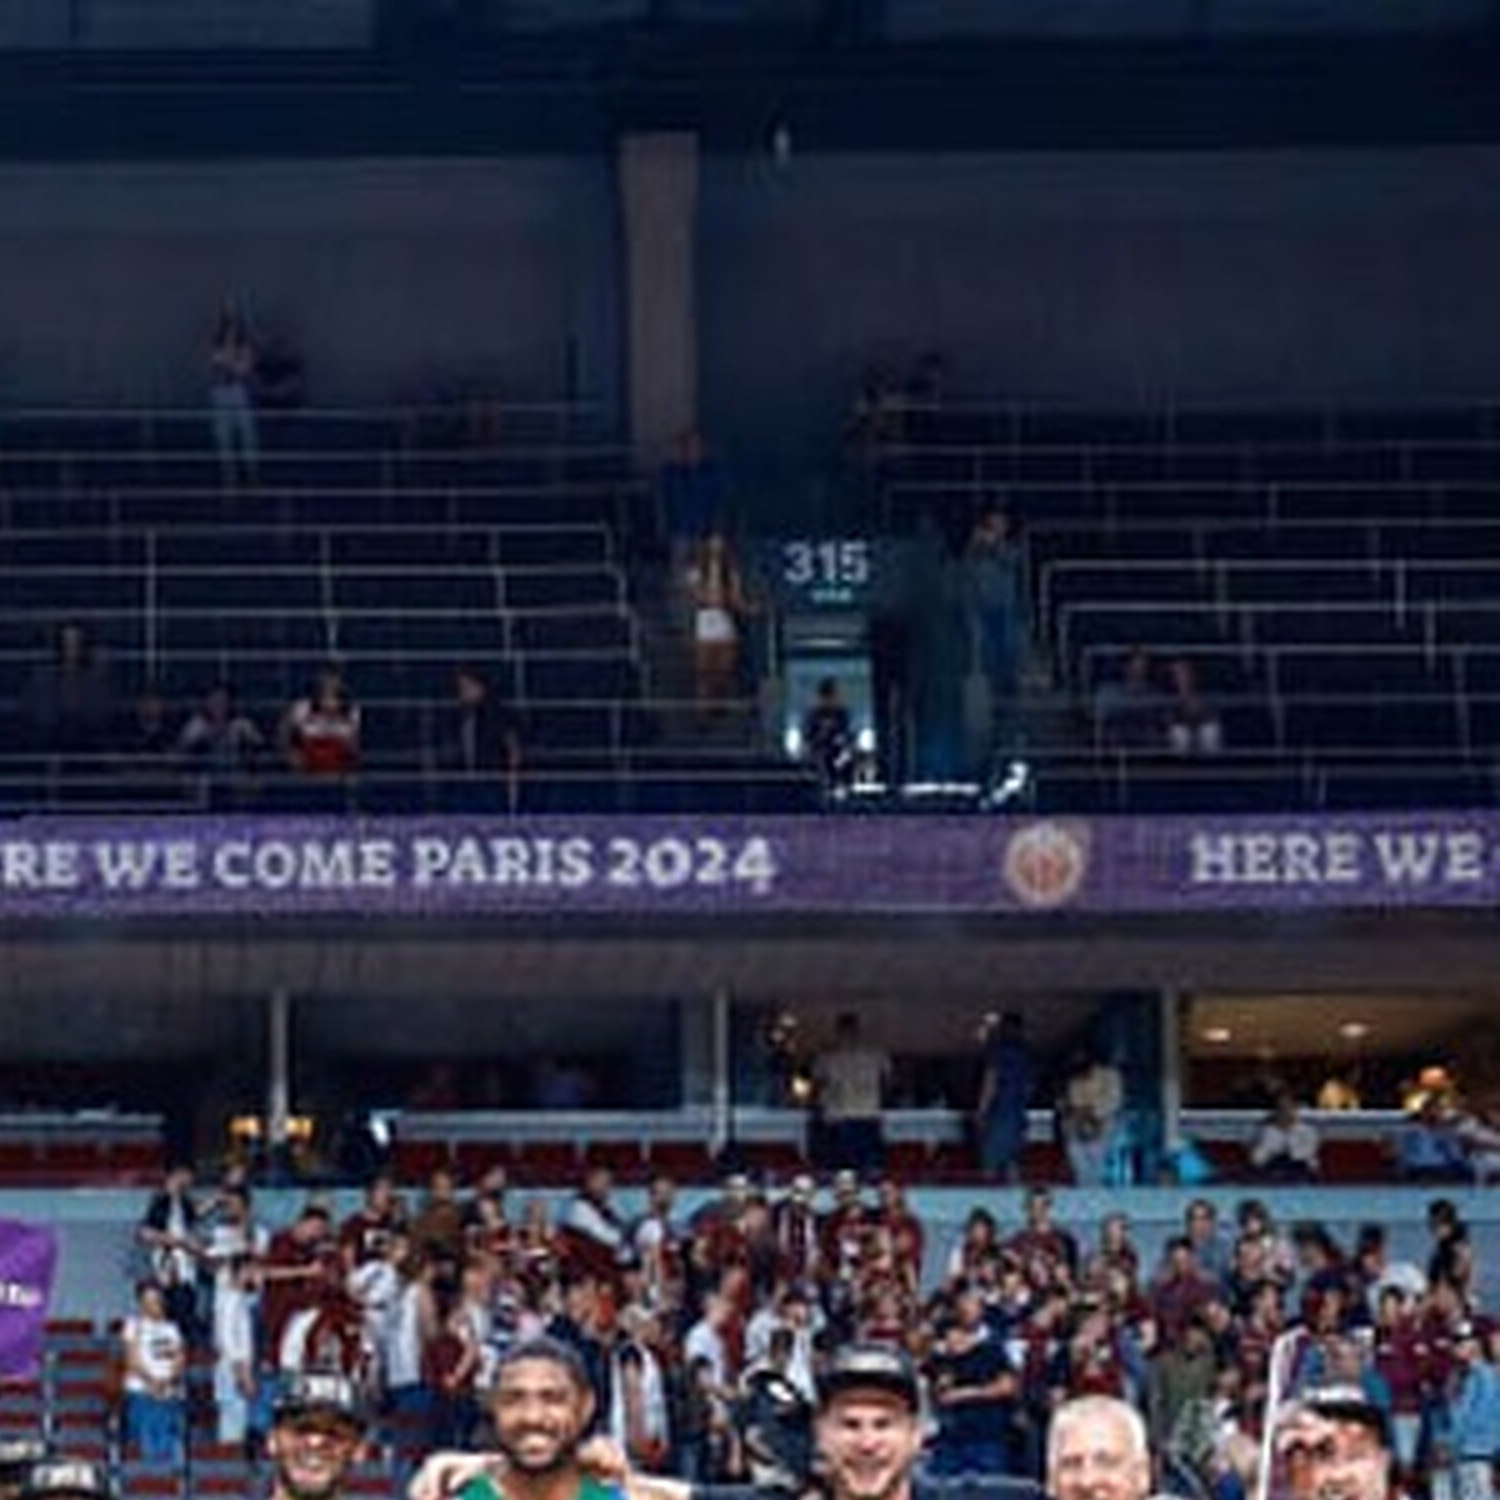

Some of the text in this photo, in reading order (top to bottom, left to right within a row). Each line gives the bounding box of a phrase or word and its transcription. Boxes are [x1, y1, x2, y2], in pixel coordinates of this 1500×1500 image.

[784, 541, 868, 583] 315
[98, 841, 199, 887] WE
[213, 839, 397, 887] COME
[412, 837, 594, 886] PARIS
[608, 838, 774, 893] 2024
[1191, 831, 1485, 883] HERE WE
